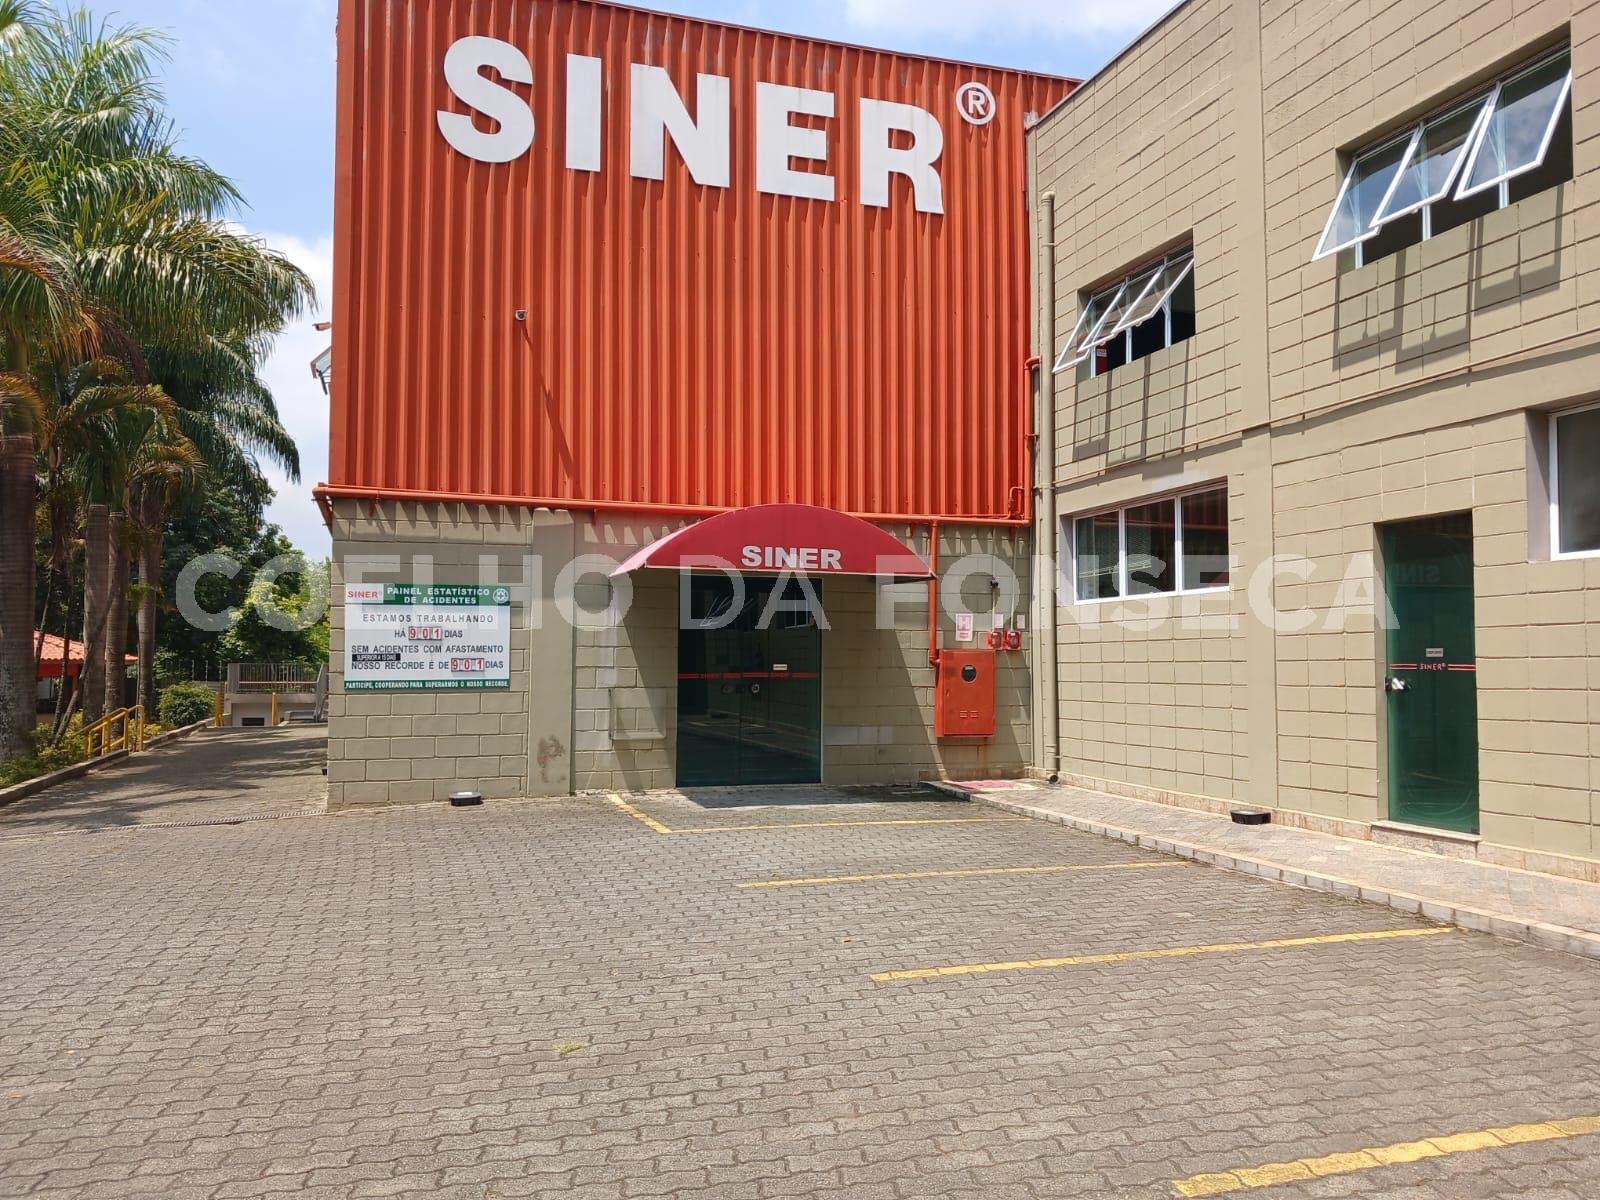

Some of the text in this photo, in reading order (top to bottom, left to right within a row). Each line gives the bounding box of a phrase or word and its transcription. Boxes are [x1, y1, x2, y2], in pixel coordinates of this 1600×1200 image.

[741, 545, 843, 569] SINER
[387, 587, 490, 596] PAINEL ESTATÍSTICO
[404, 596, 417, 604] DE
[363, 614, 494, 623] ESTAMOS TRABALHANDO
[394, 628, 406, 638] HÁ
[444, 630, 463, 638] DIAS
[351, 645, 504, 653] SEM ACIDENTES COM AFASTAMENTO
[351, 661, 381, 670] NOSSO
[385, 661, 425, 670] RECORDE
[438, 661, 449, 670] DE
[485, 661, 504, 669] DIAS
